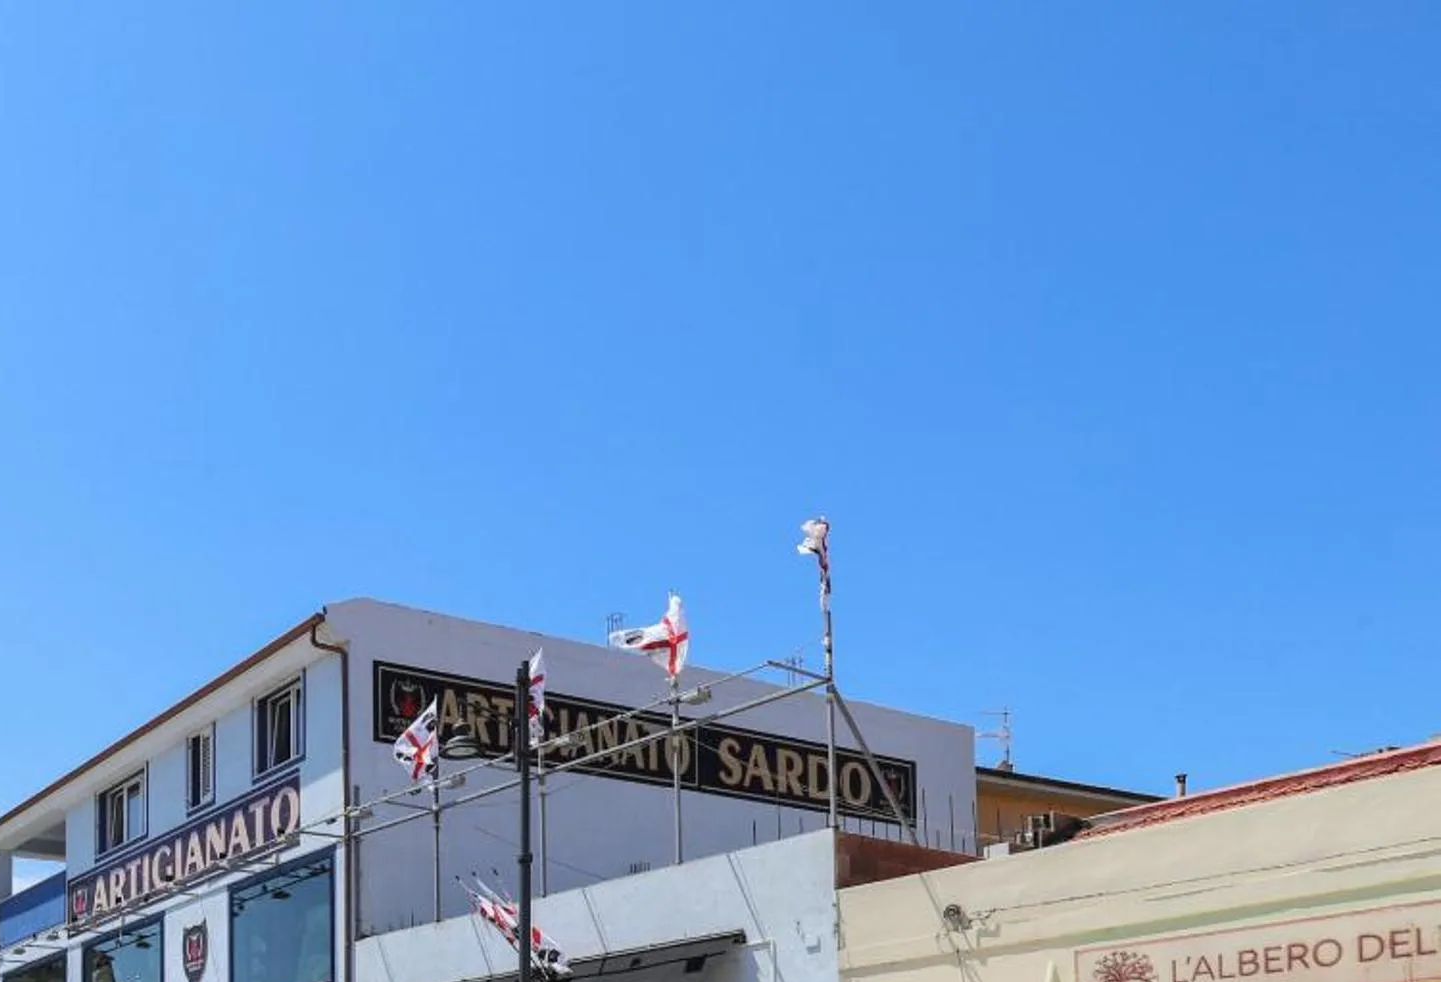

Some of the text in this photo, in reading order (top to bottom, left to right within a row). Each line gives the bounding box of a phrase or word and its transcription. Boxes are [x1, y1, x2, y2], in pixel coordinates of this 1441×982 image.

[437, 688, 872, 806] ARTIANATO SARDO
[92, 786, 300, 916] ARTIGIANATO
[1357, 923, 1441, 963] DEL
